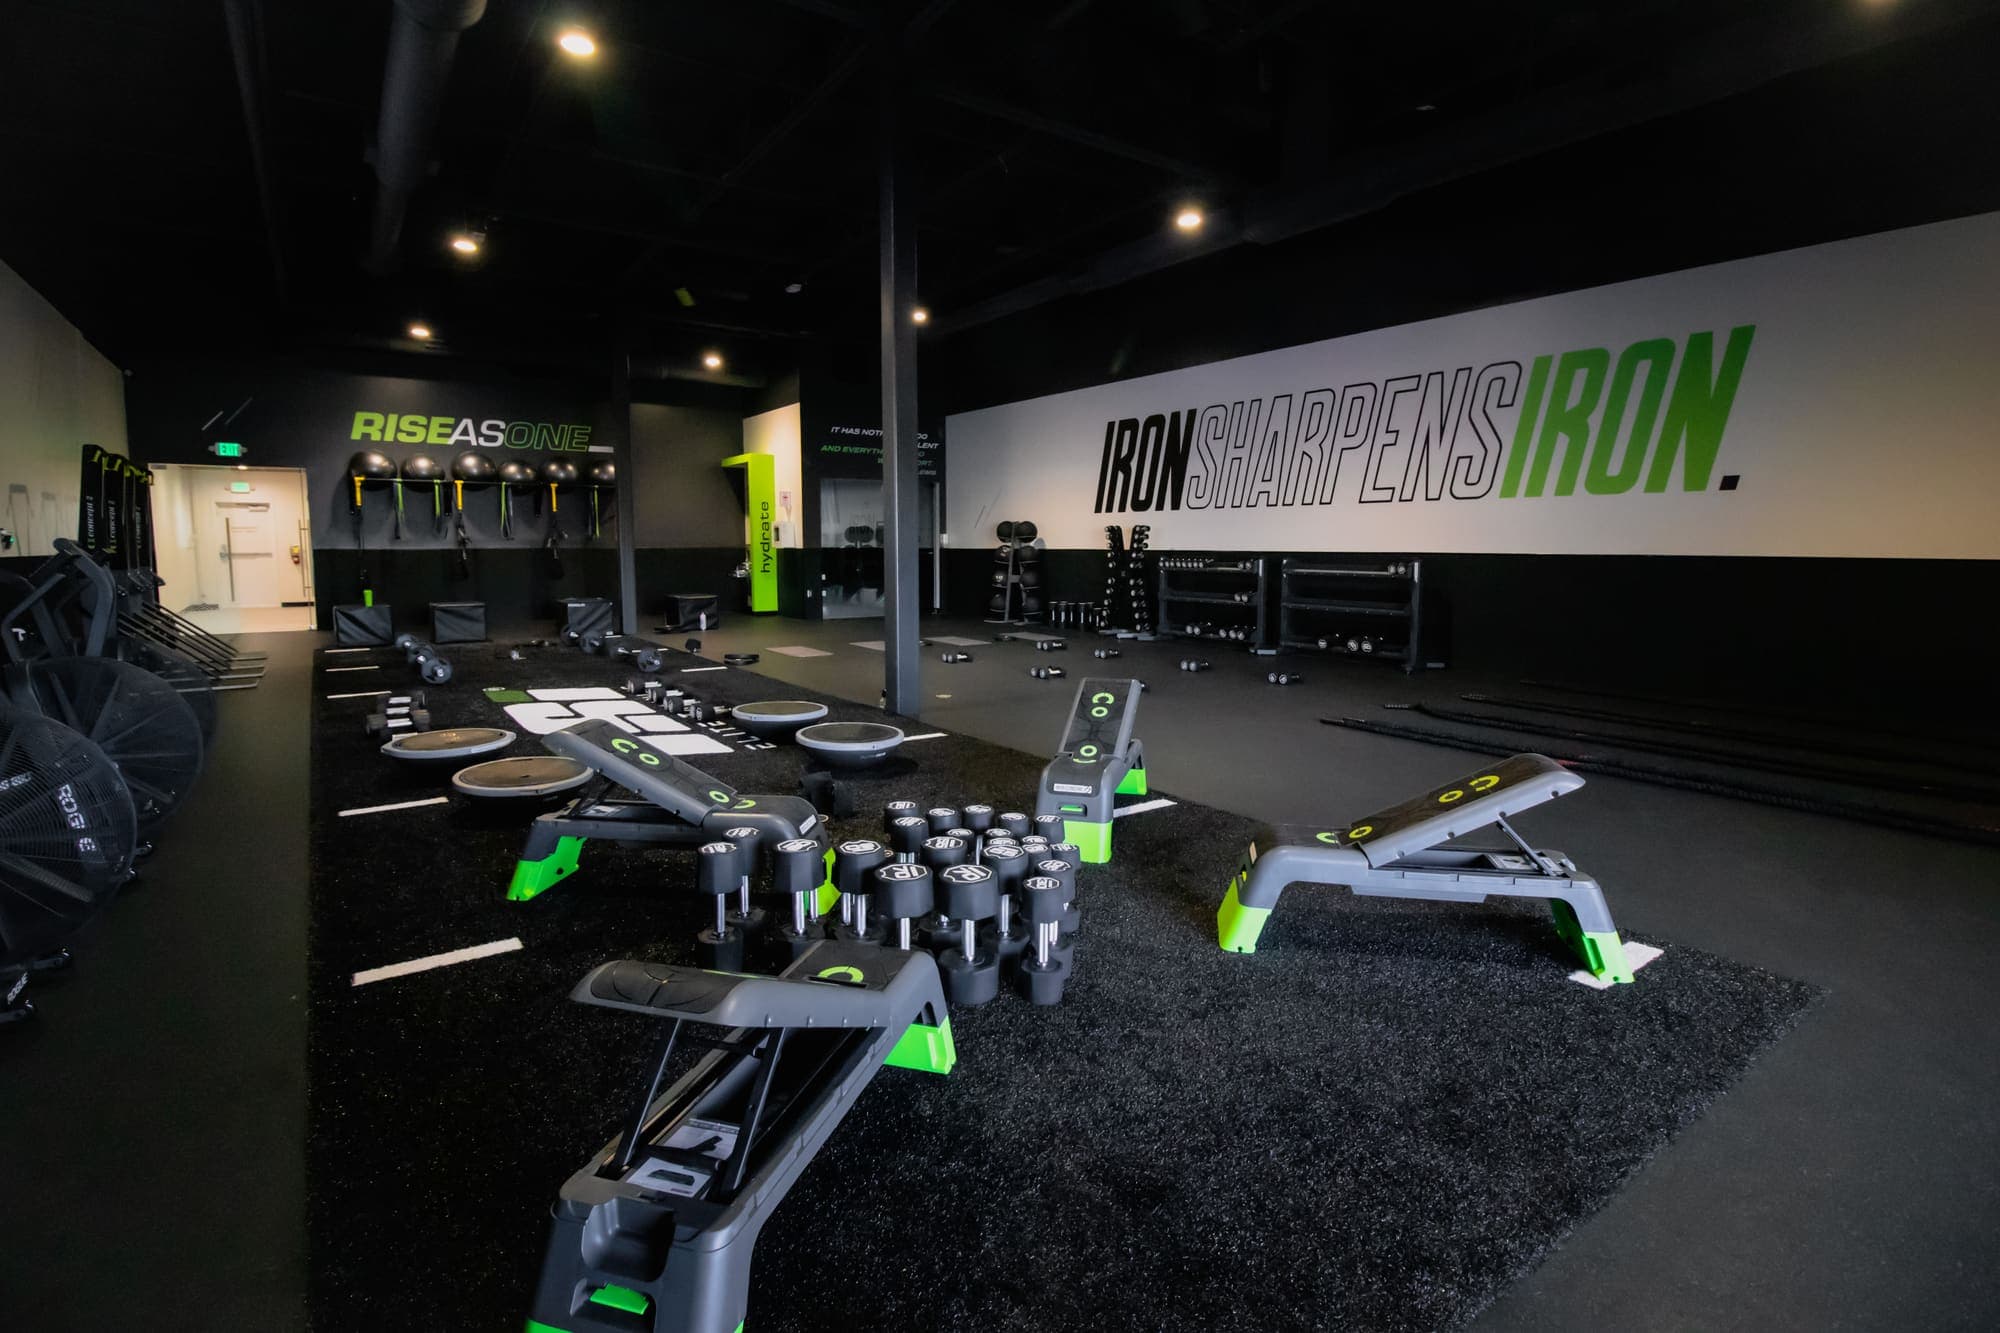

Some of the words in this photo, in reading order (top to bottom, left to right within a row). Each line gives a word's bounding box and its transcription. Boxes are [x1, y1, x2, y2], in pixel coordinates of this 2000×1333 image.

[841, 427, 860, 435] HAS
[820, 444, 841, 453] AND
[760, 501, 773, 573] hydrate
